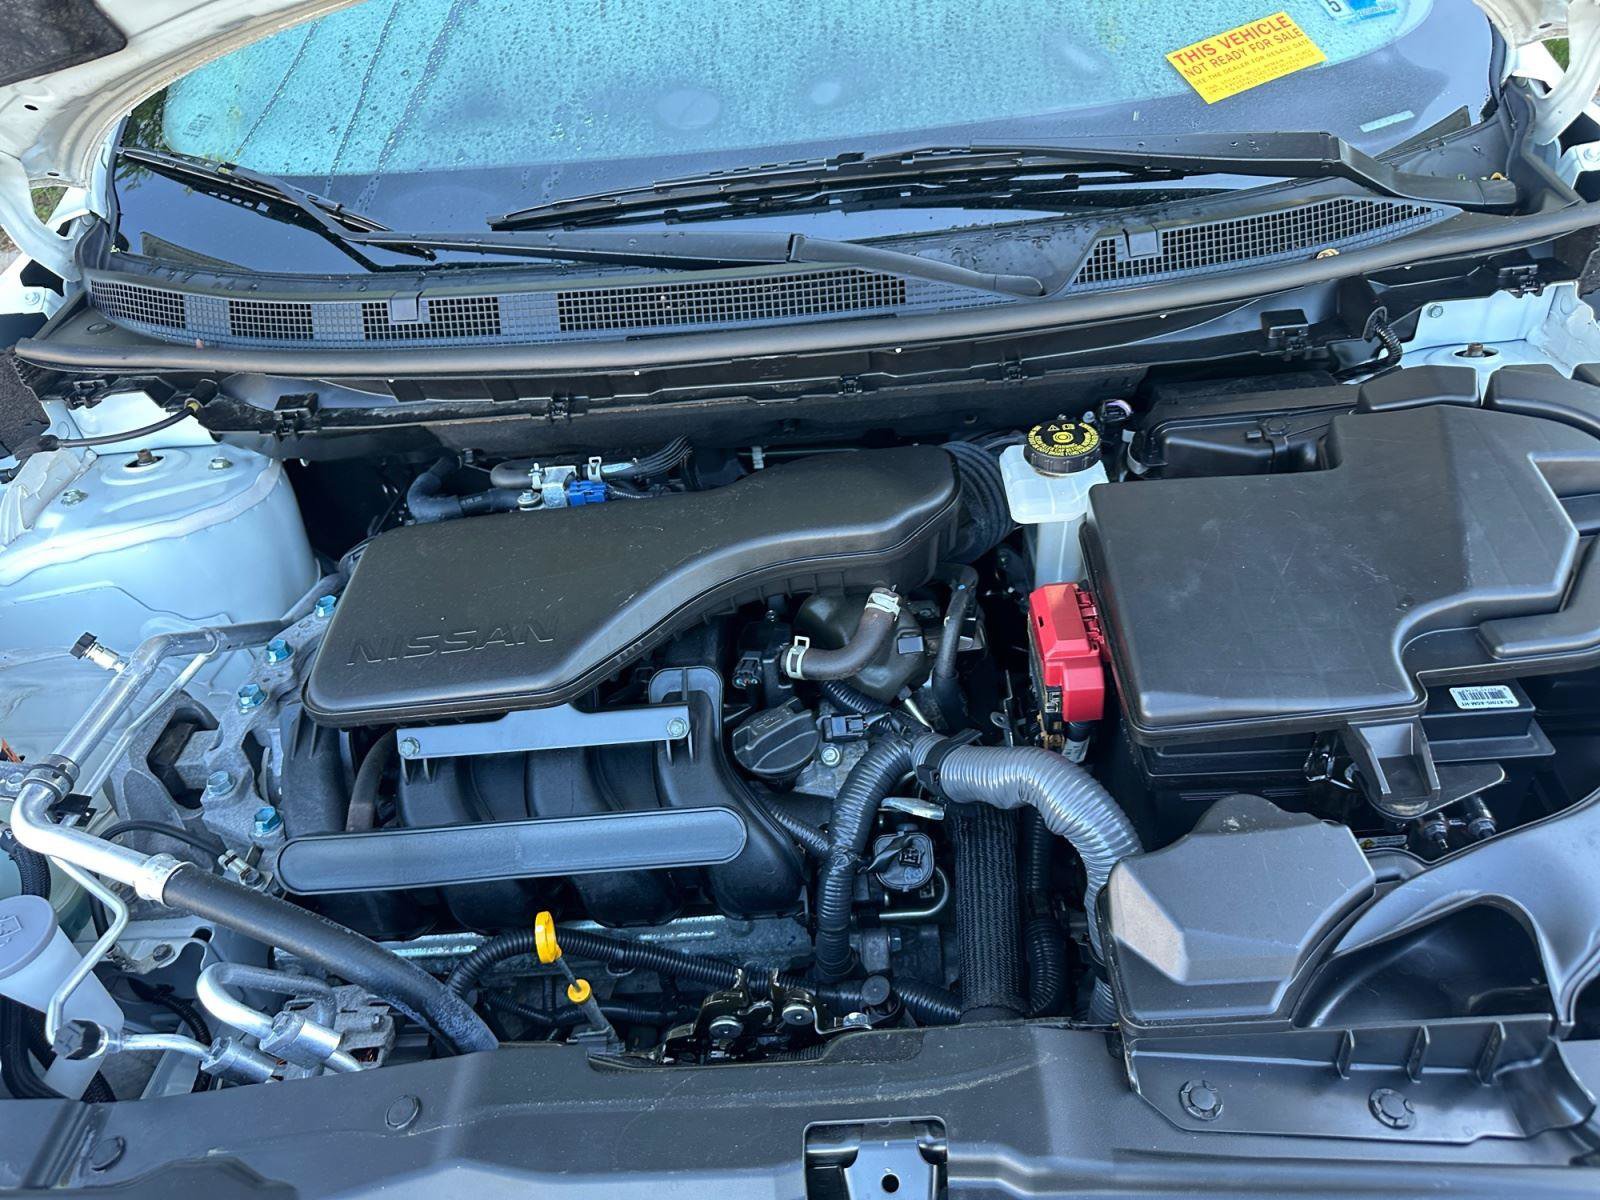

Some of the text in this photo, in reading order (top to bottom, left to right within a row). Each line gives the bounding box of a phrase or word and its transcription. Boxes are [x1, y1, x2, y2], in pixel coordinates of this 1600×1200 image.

[1172, 15, 1292, 66] THIS VEHICLE
[1182, 27, 1303, 77] NOT READY FOR SALE
[1222, 60, 1250, 74] DEALER
[345, 617, 558, 666] NISSAN
